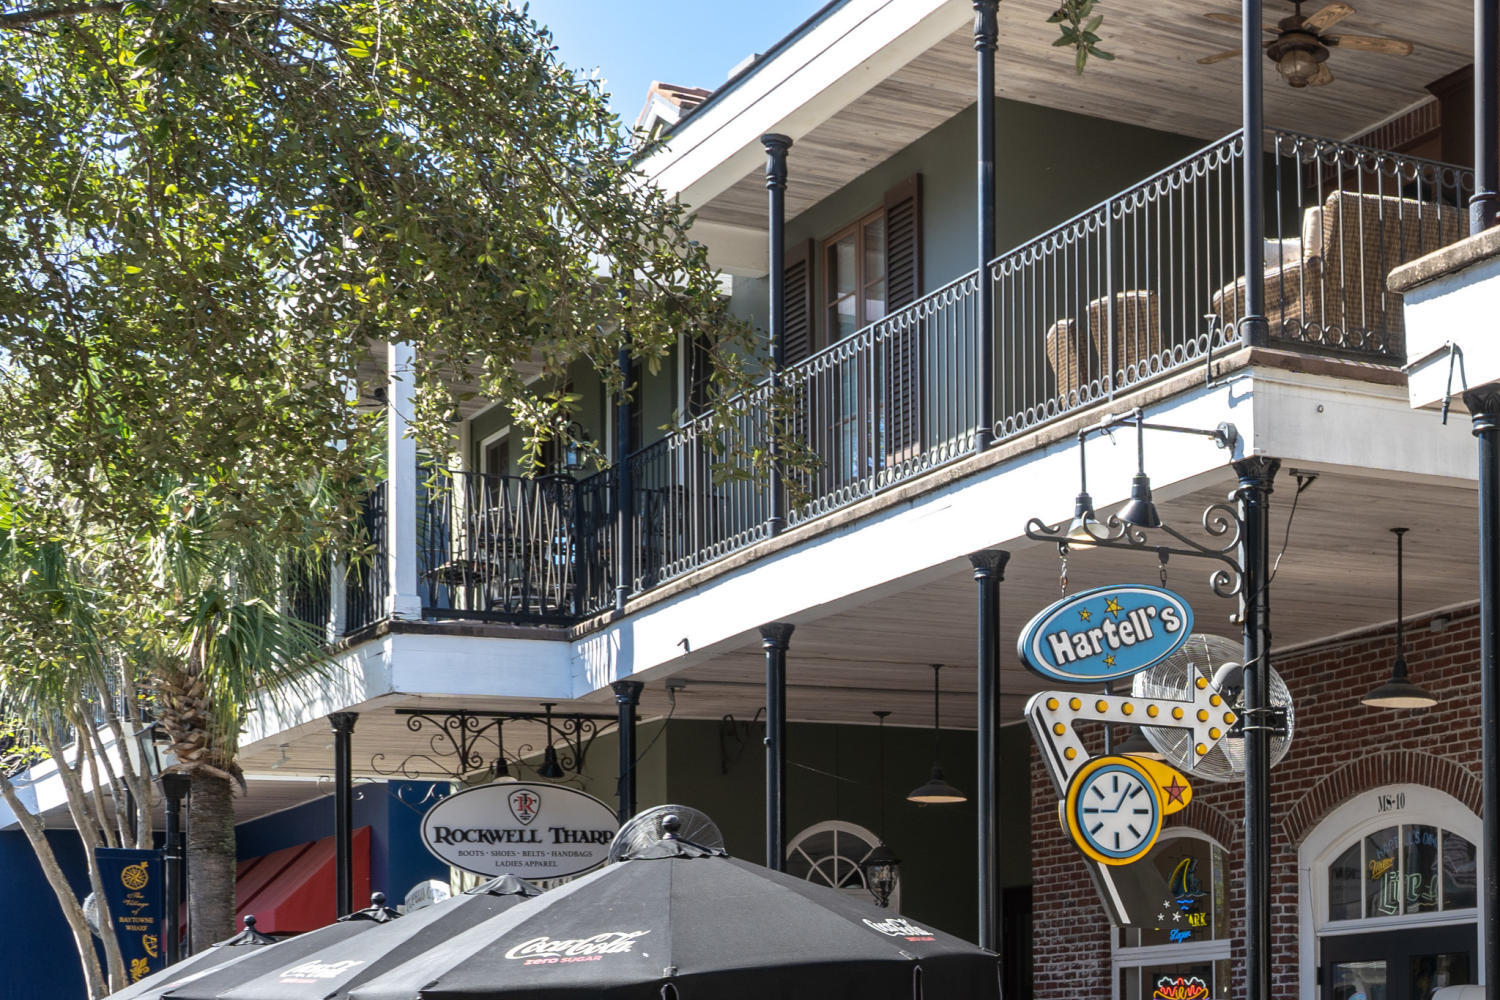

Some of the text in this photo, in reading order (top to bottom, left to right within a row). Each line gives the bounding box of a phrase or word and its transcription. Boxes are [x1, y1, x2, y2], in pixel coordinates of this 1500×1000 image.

[1046, 606, 1181, 666] Hartell's
[1377, 792, 1406, 813] MS-10
[559, 955, 604, 964] SUGAR
